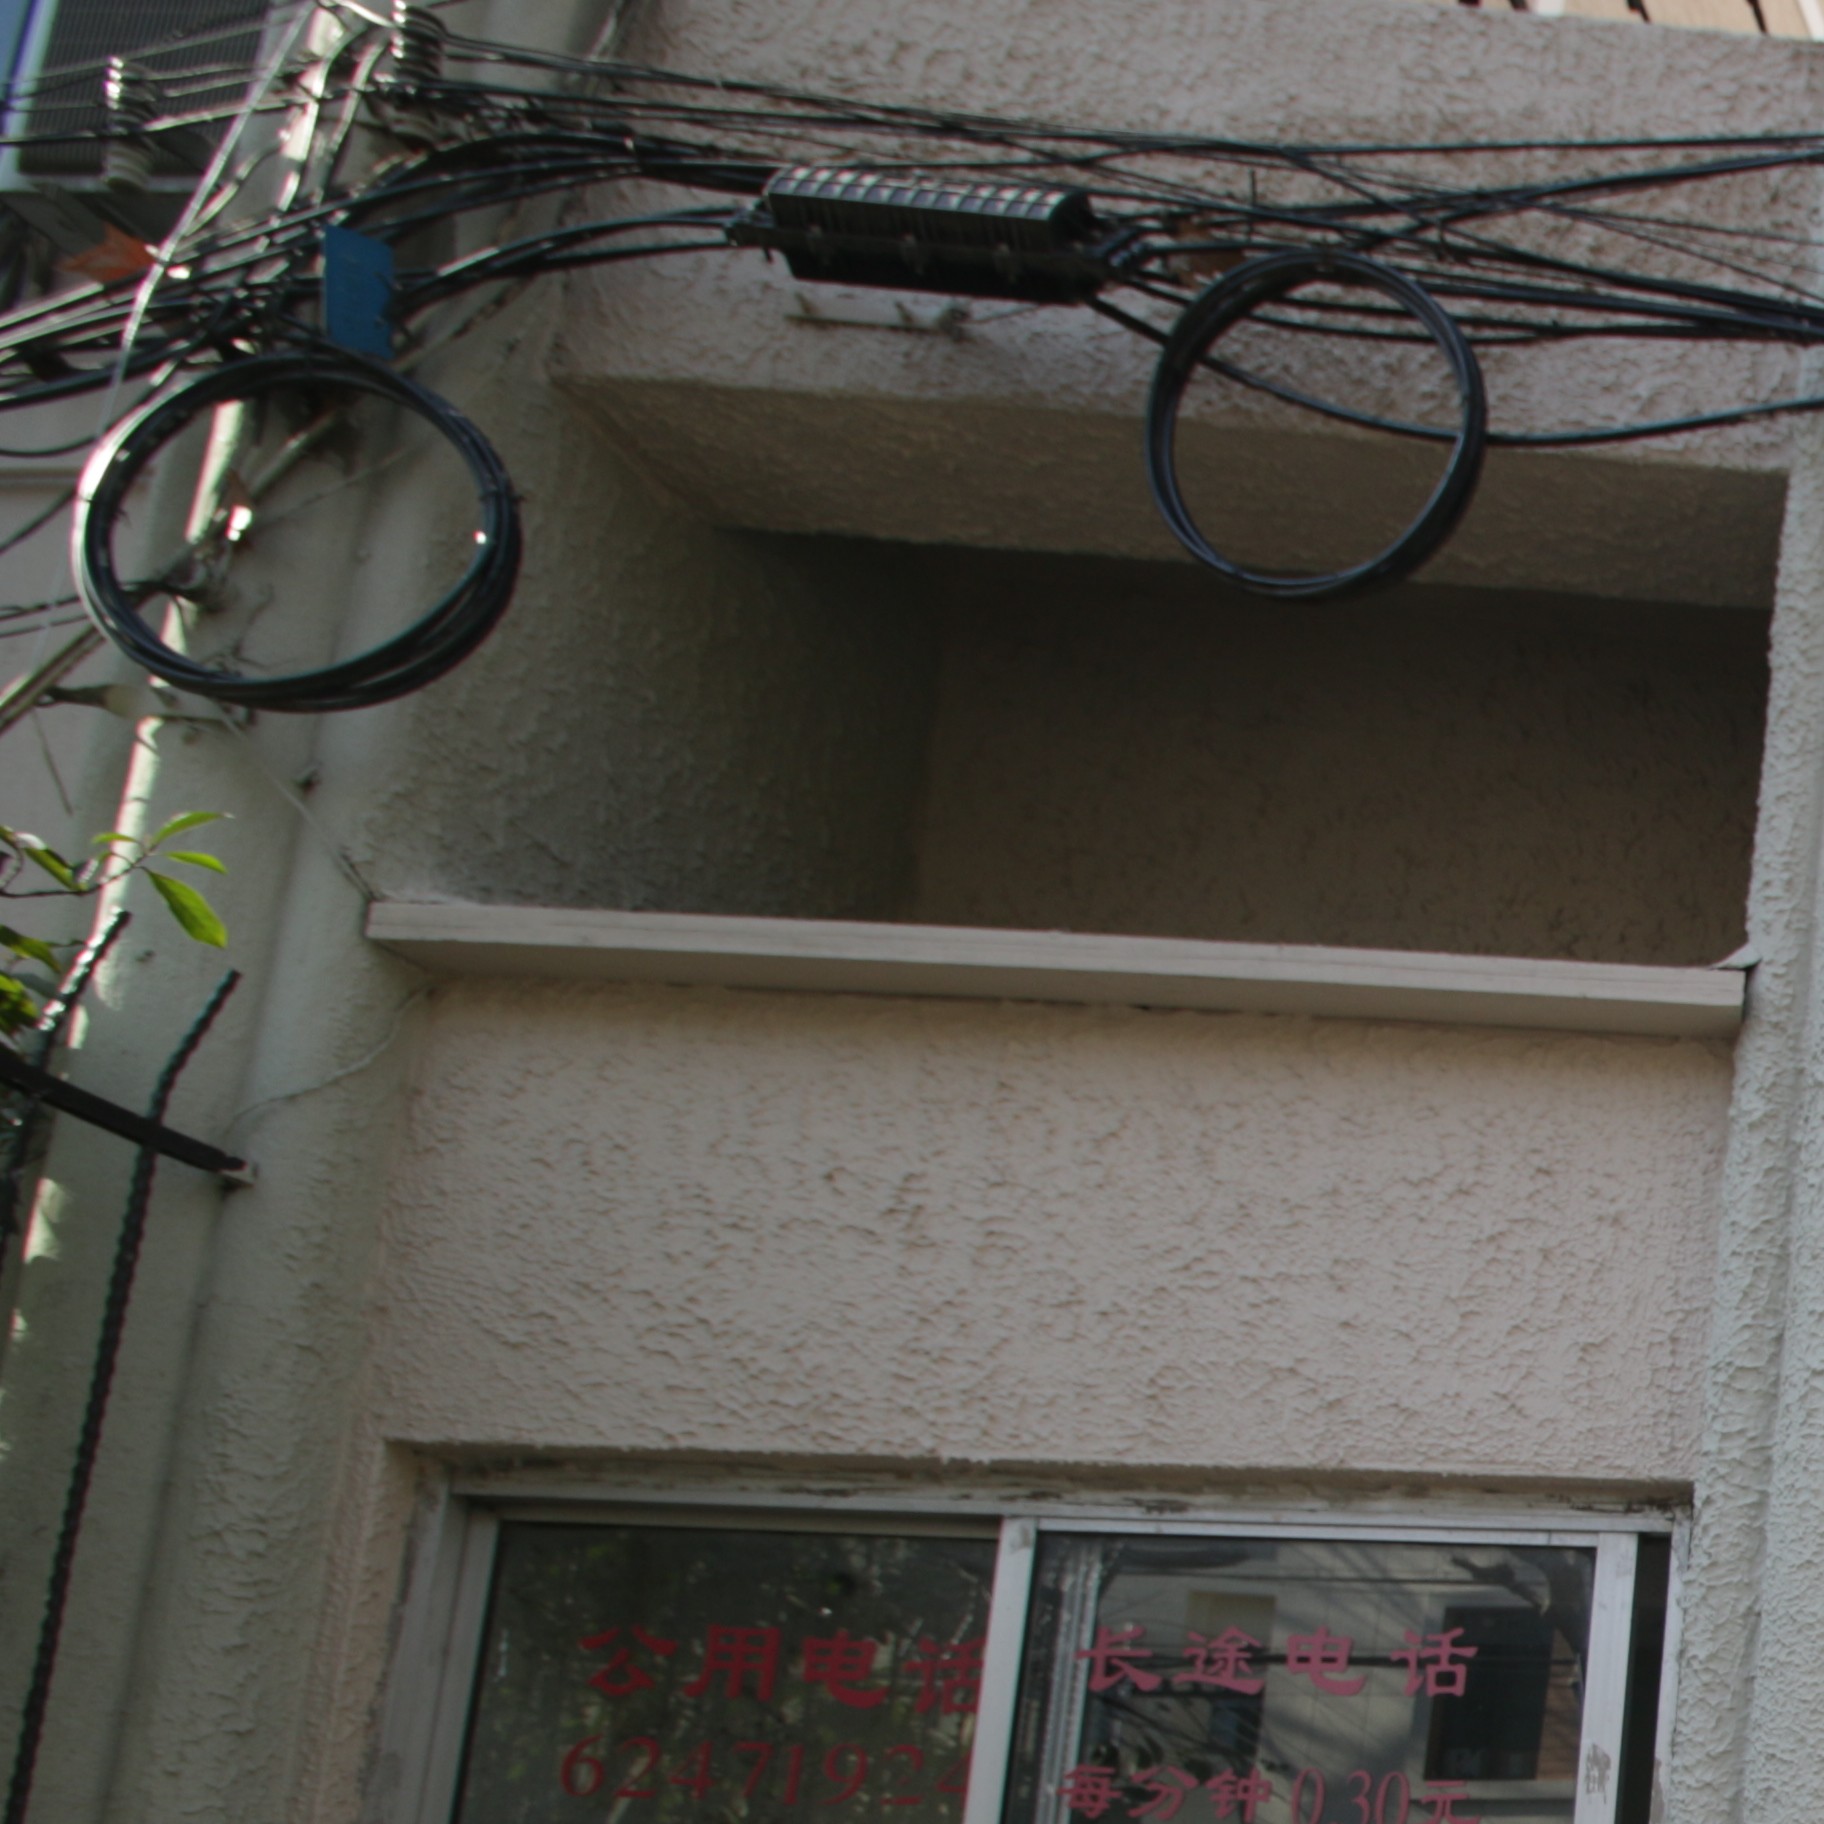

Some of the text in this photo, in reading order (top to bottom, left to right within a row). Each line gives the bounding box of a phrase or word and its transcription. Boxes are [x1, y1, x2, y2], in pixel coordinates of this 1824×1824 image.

[578, 1623, 987, 1714] 公用电话
[1076, 1625, 1479, 1698] 长途电话
